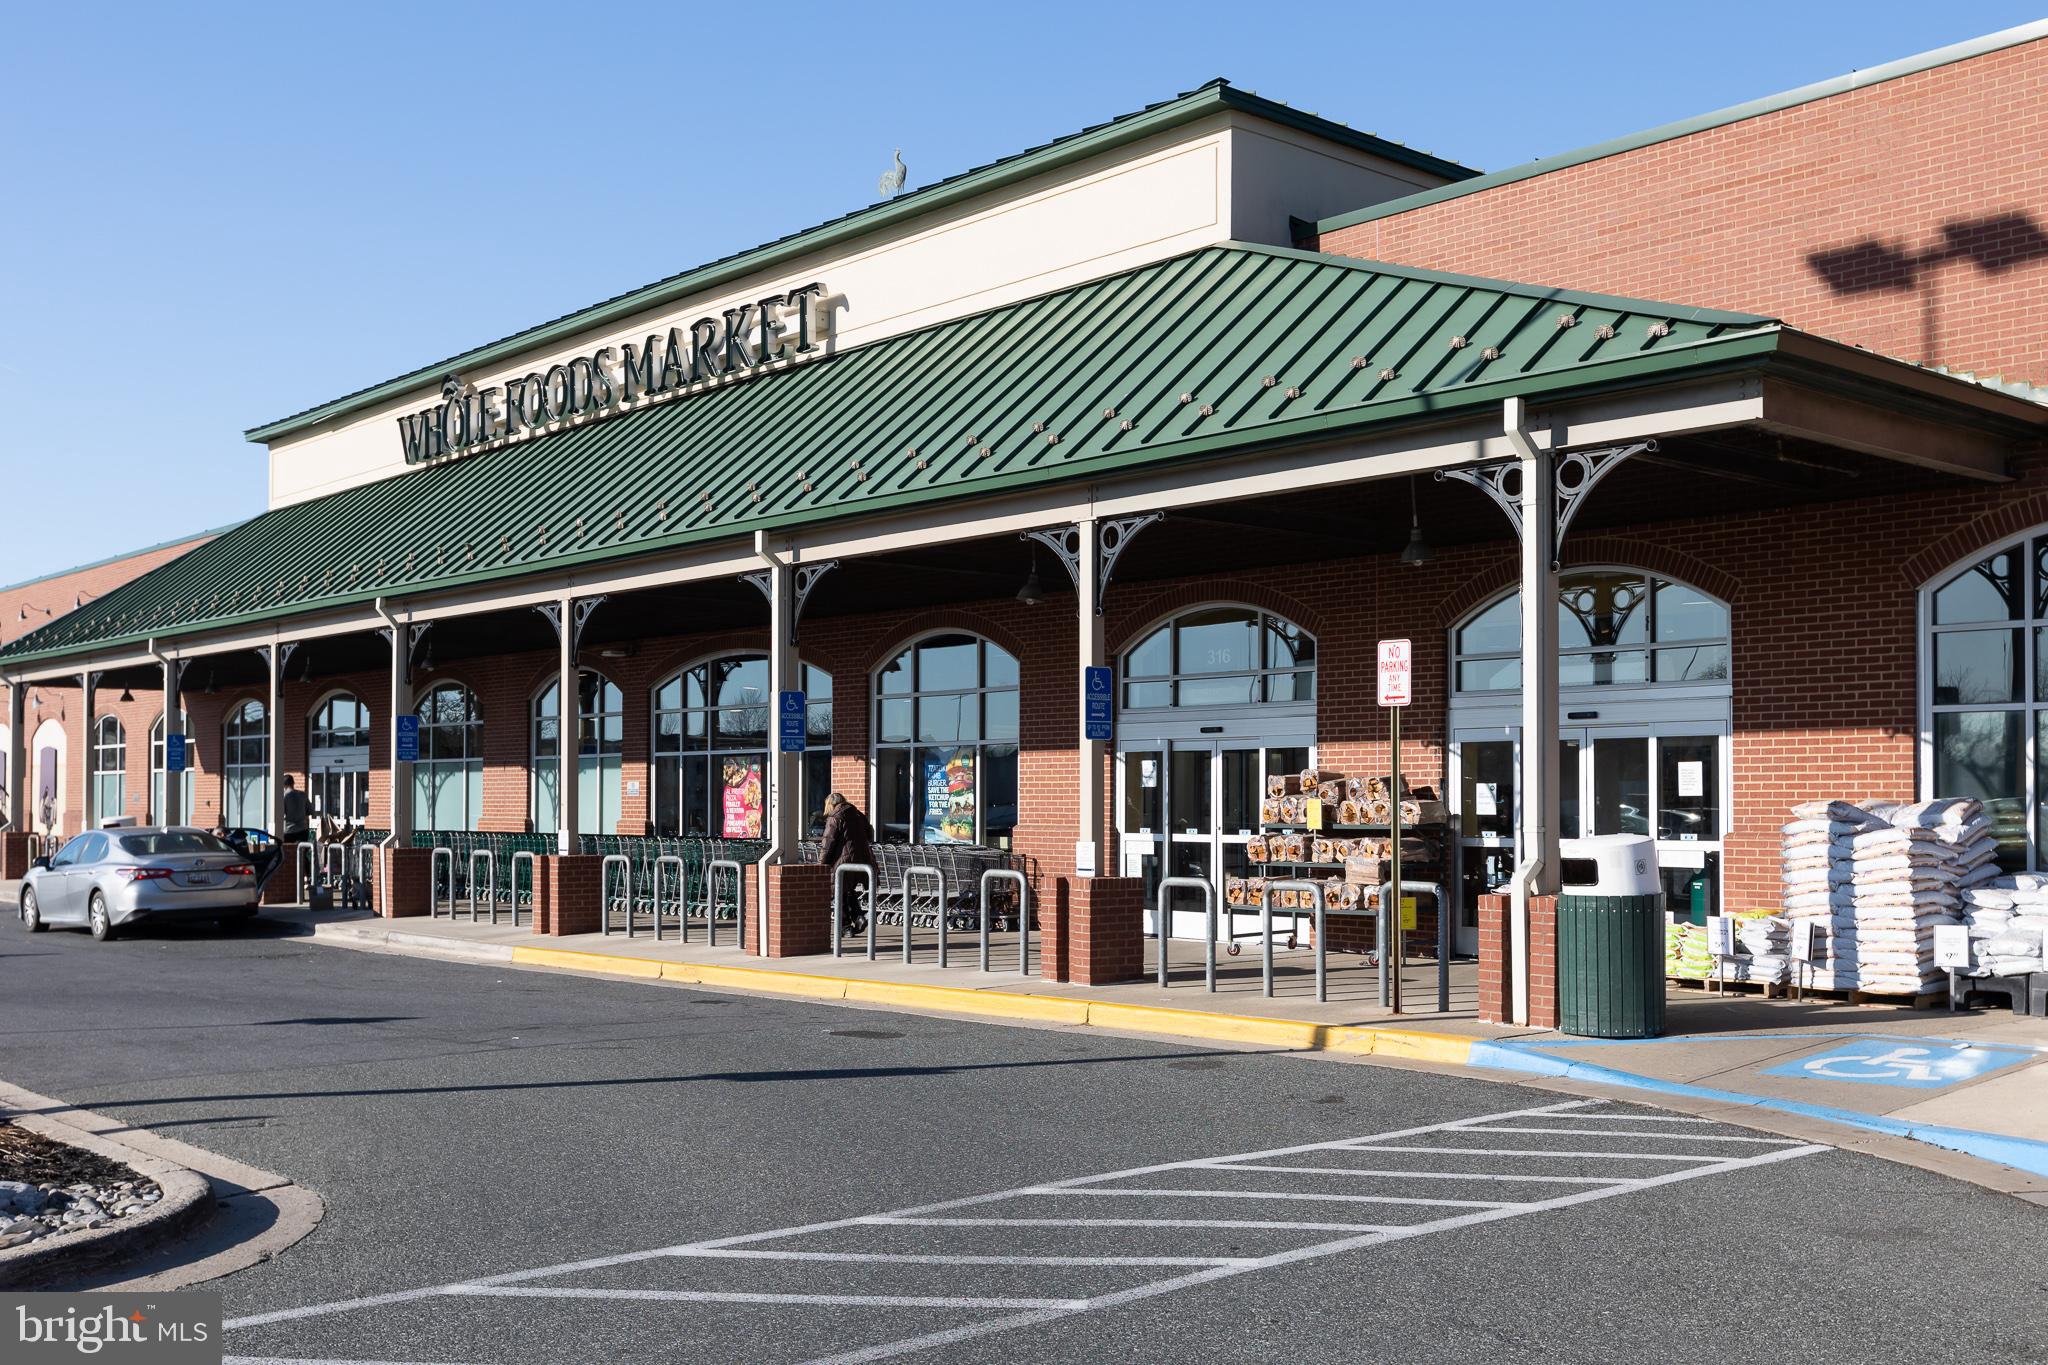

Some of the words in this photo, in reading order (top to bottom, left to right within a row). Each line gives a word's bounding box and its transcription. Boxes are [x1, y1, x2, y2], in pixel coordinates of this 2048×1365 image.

[504, 346, 619, 436] FOODS
[621, 283, 828, 403] MARKET
[1207, 648, 1231, 665] 316
[1388, 646, 1401, 659] NO
[1380, 660, 1408, 673] PARKING
[1388, 674, 1400, 682] ANY
[1387, 683, 1401, 692] TIME
